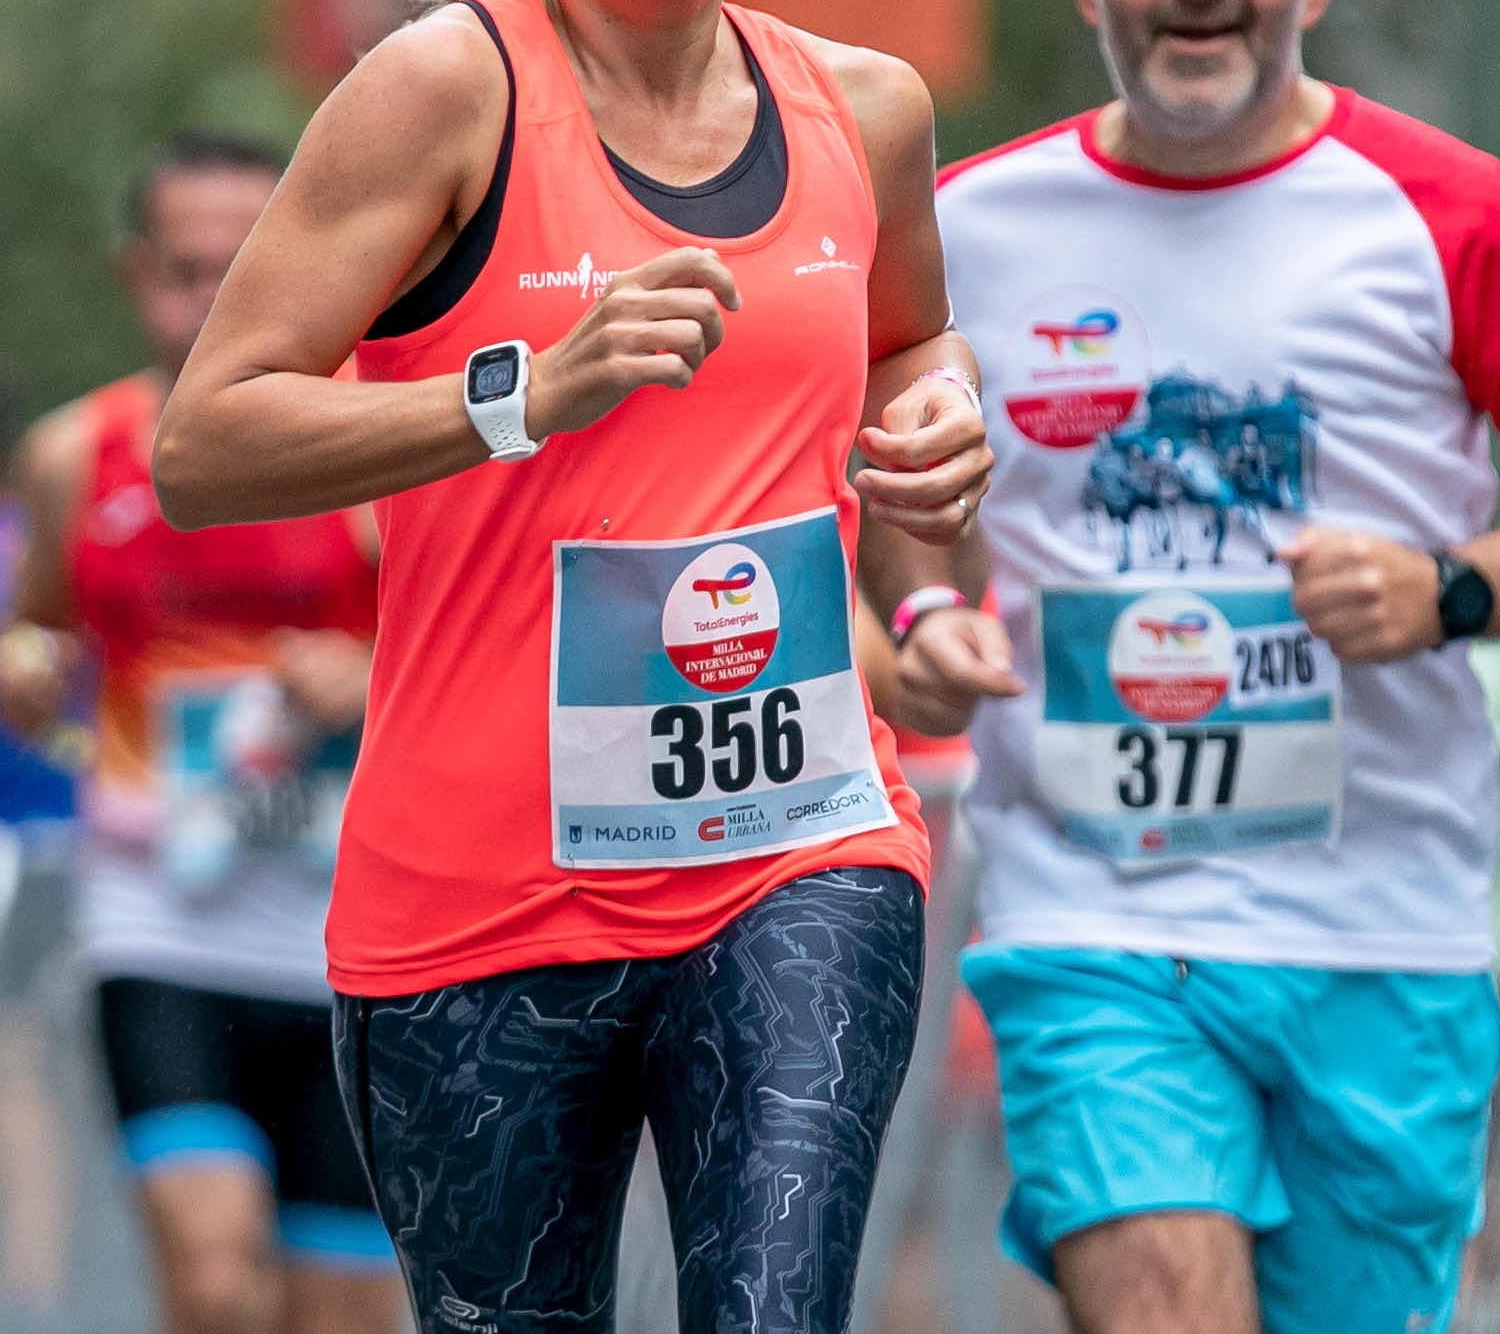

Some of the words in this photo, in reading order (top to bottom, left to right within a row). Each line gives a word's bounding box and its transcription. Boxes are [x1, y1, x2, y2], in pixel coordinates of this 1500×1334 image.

[694, 611, 759, 633] TotalEnergies
[712, 639, 744, 656] MILLA
[1236, 632, 1315, 692] 2476
[701, 672, 717, 685] DE
[718, 663, 758, 680] MADRID
[650, 687, 804, 800] 356
[1117, 724, 1242, 807] 377
[727, 809, 765, 824] MILLA
[595, 825, 677, 842] MADRID
[727, 821, 771, 838] URBANA
